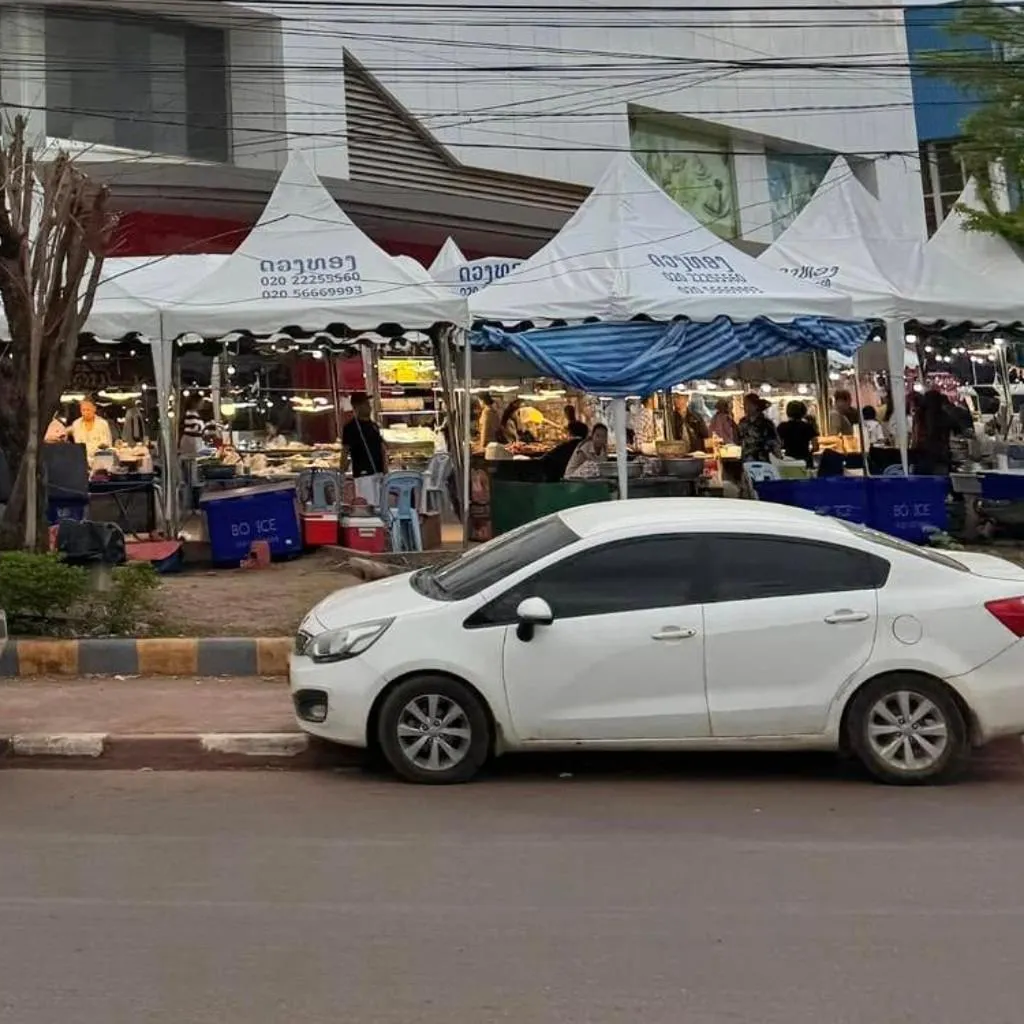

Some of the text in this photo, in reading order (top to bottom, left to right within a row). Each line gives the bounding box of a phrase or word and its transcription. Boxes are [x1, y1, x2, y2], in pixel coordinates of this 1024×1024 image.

[260, 272, 361, 286] 020 22255560
[262, 286, 363, 299] 020 56669993
[231, 518, 277, 536] BO ICE
